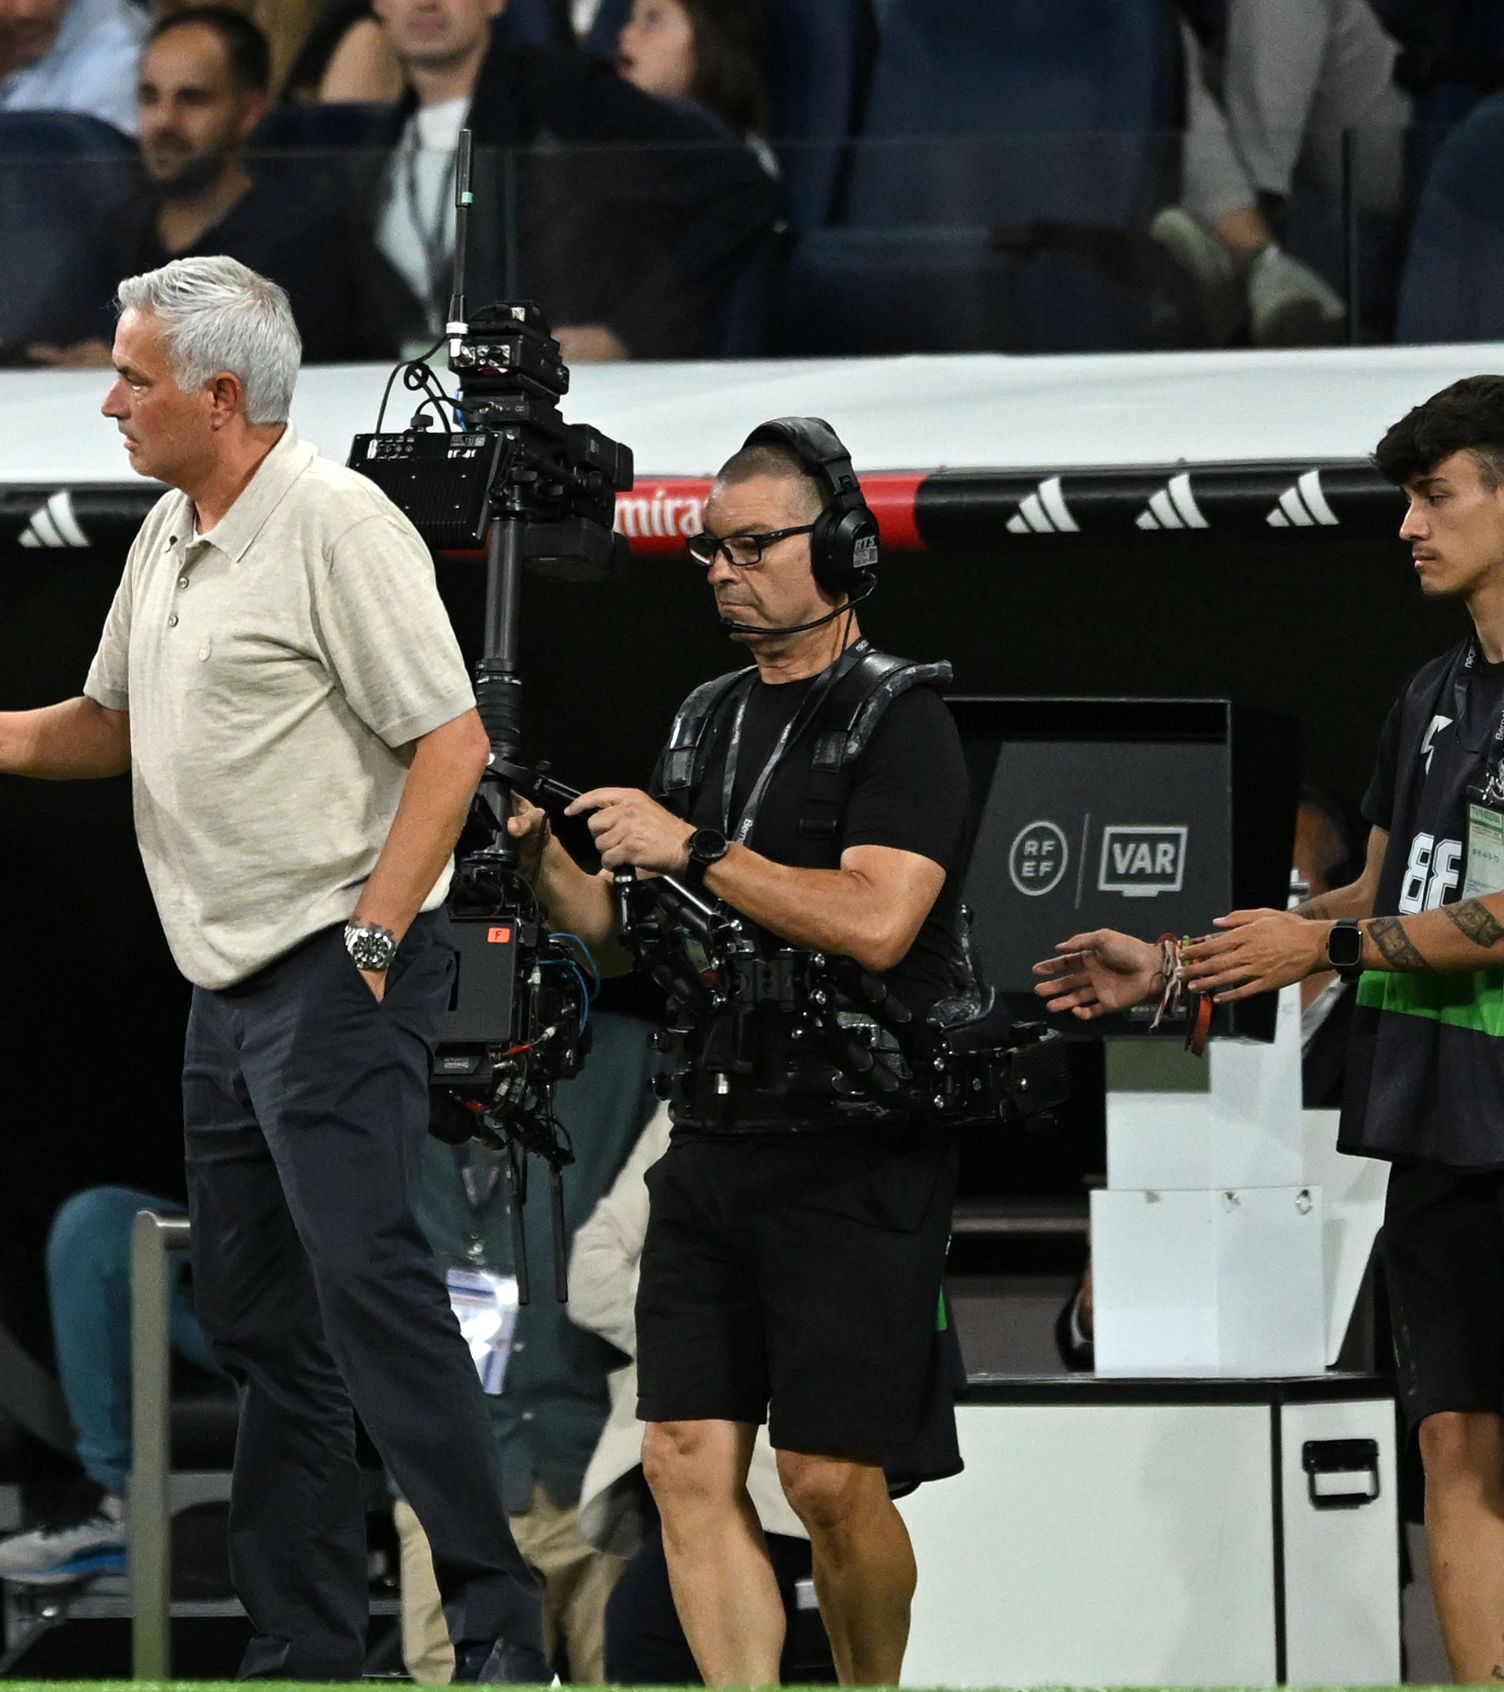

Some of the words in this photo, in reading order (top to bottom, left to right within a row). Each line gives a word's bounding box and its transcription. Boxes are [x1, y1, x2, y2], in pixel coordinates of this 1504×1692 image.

[613, 489, 705, 538] mira
[1024, 840, 1056, 856] RF
[1112, 843, 1176, 874] VAR
[1021, 861, 1055, 877] EF
